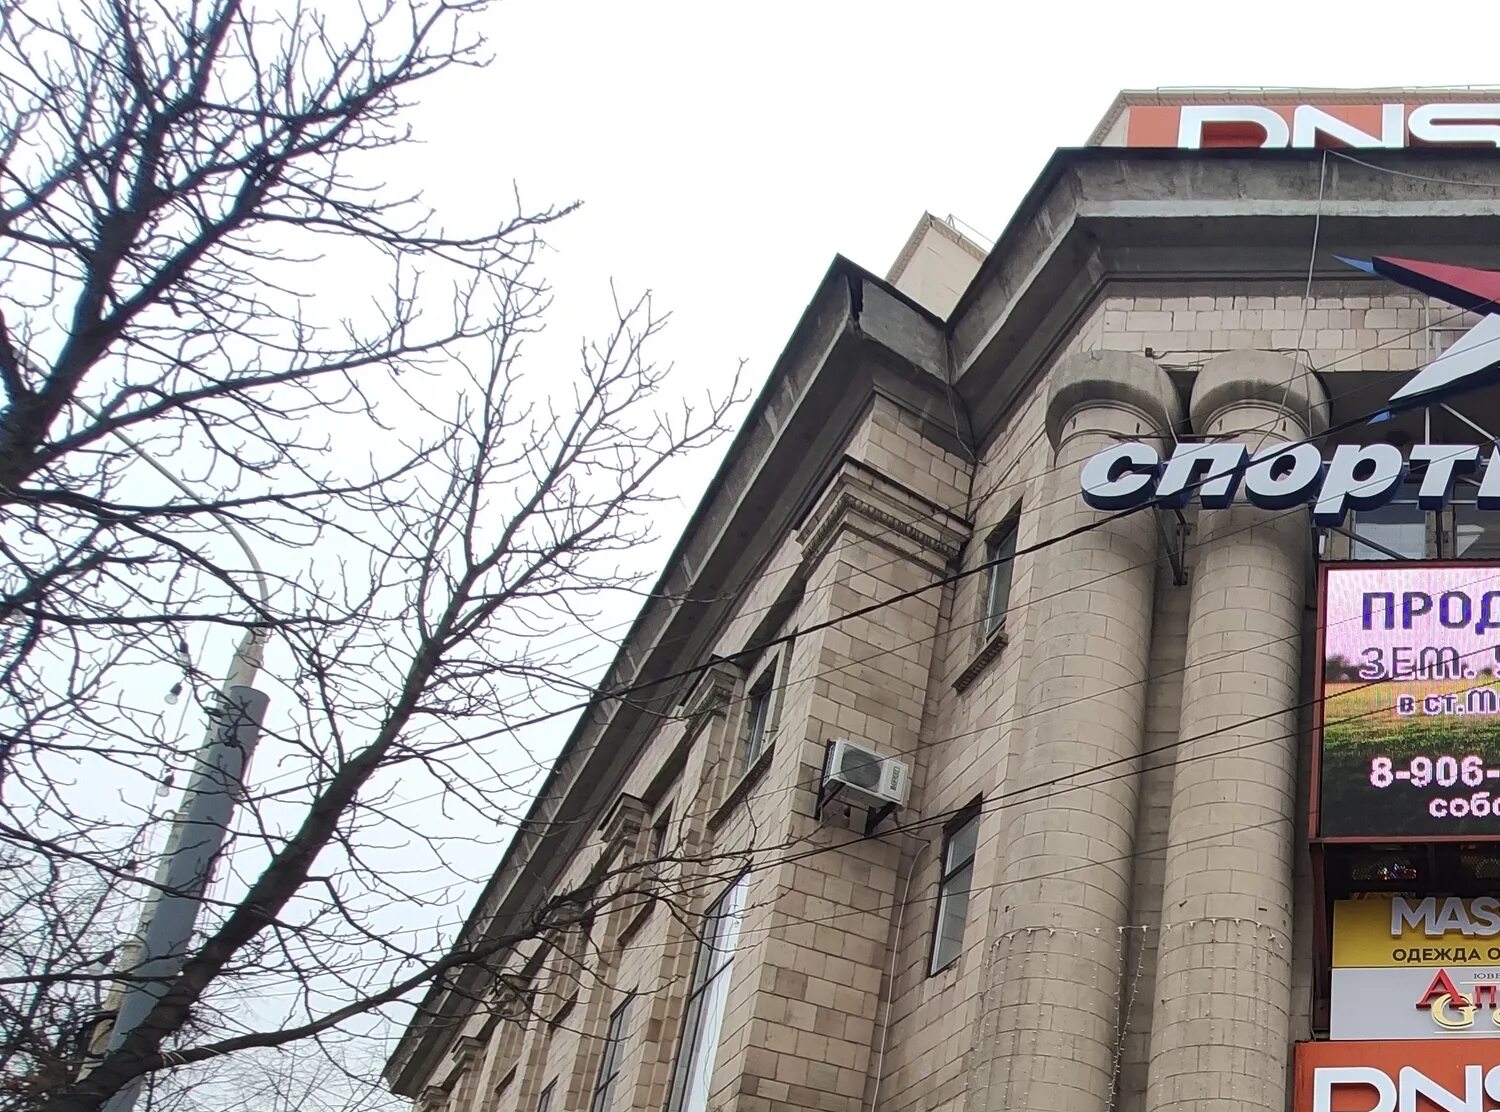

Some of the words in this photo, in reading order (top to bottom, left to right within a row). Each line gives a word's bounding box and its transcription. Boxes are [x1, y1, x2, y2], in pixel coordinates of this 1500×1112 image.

[1359, 646, 1476, 681] ЗЕМ.
[1396, 695, 1416, 715] в
[1392, 946, 1481, 963] ОДЕЖДА
